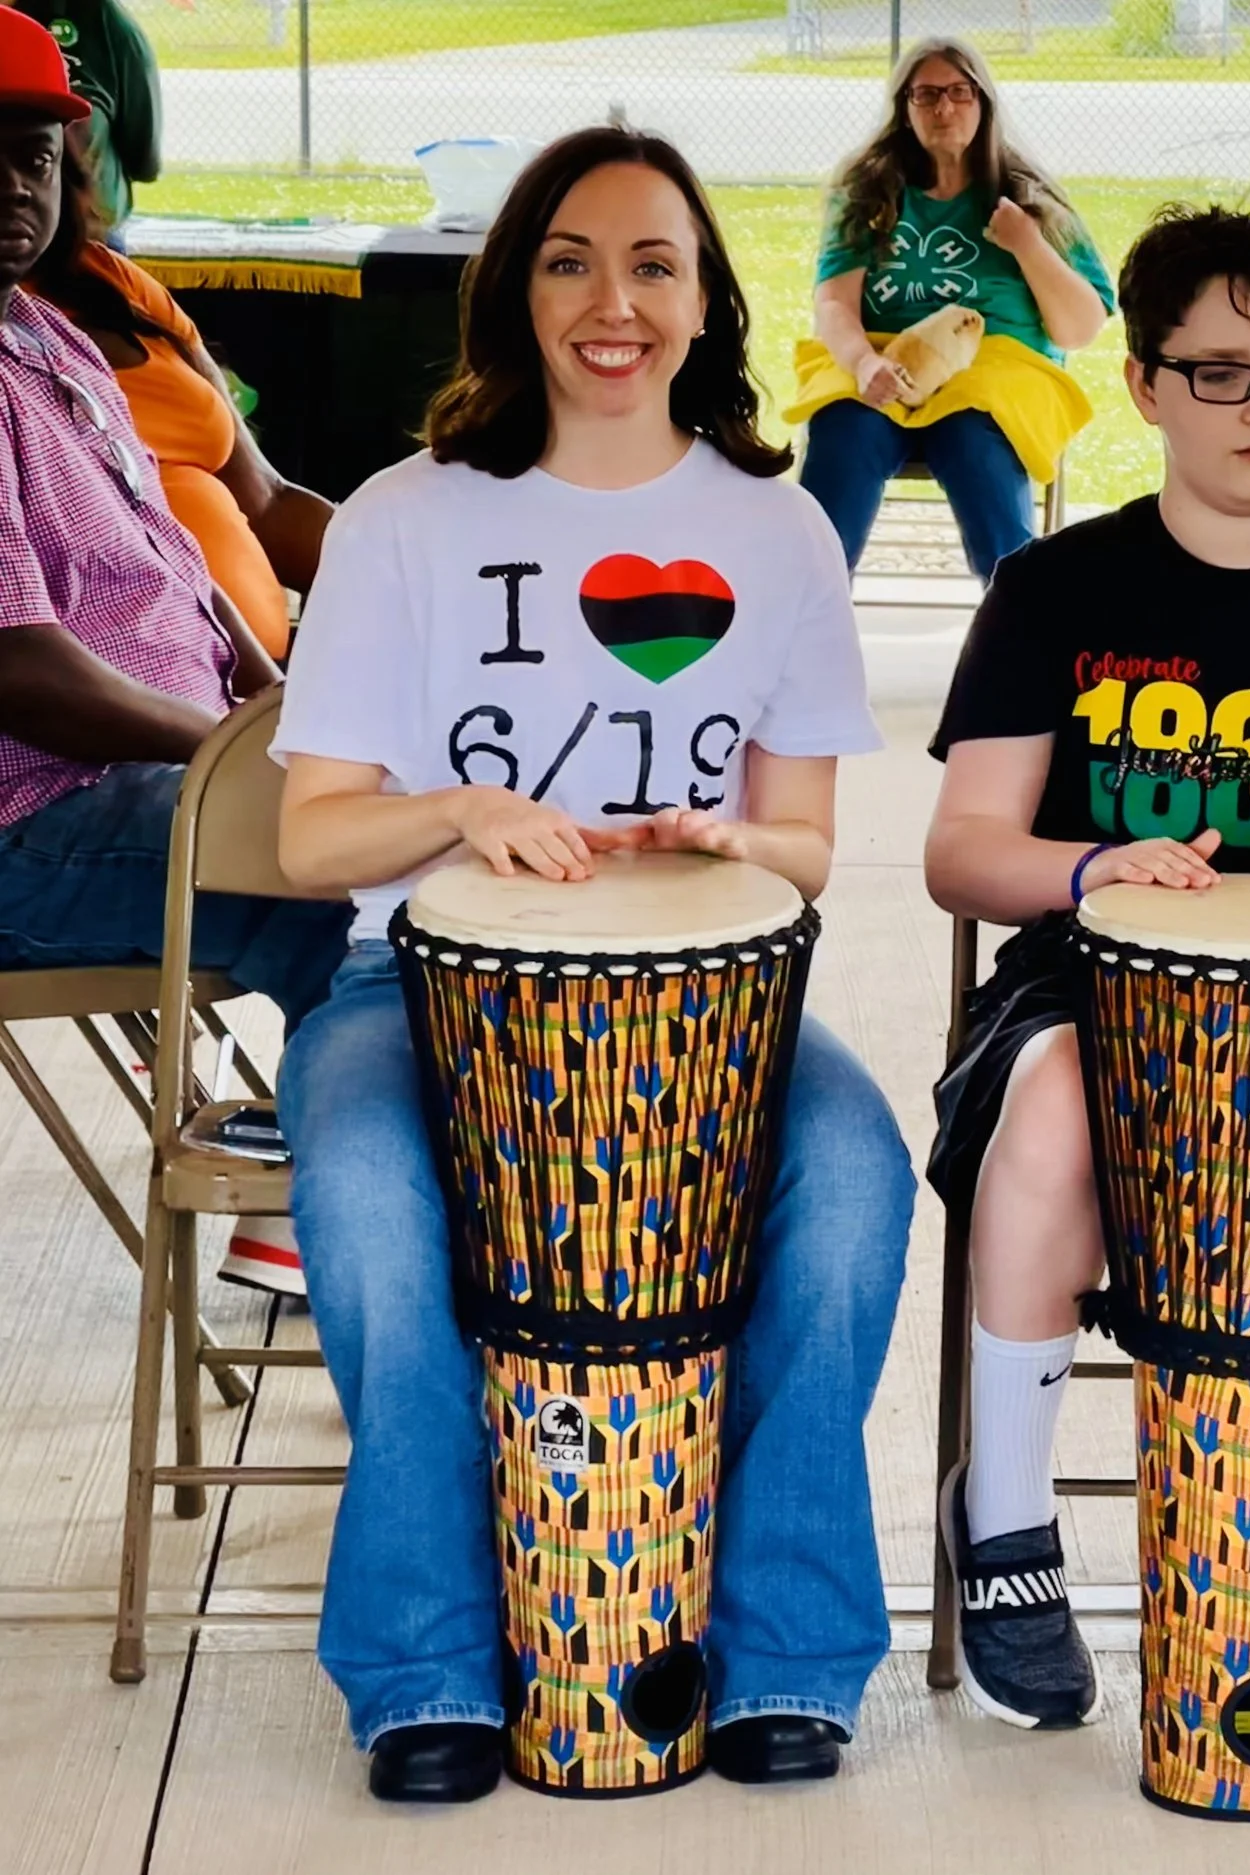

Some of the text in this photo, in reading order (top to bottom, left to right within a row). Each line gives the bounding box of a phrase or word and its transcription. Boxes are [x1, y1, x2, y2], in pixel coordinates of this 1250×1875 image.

[935, 240, 963, 263] H
[872, 275, 962, 302] H H
[478, 562, 545, 665] I
[1074, 651, 1201, 691] Celebrate
[449, 702, 740, 815] 6/19
[539, 1445, 584, 1462] TOCA
